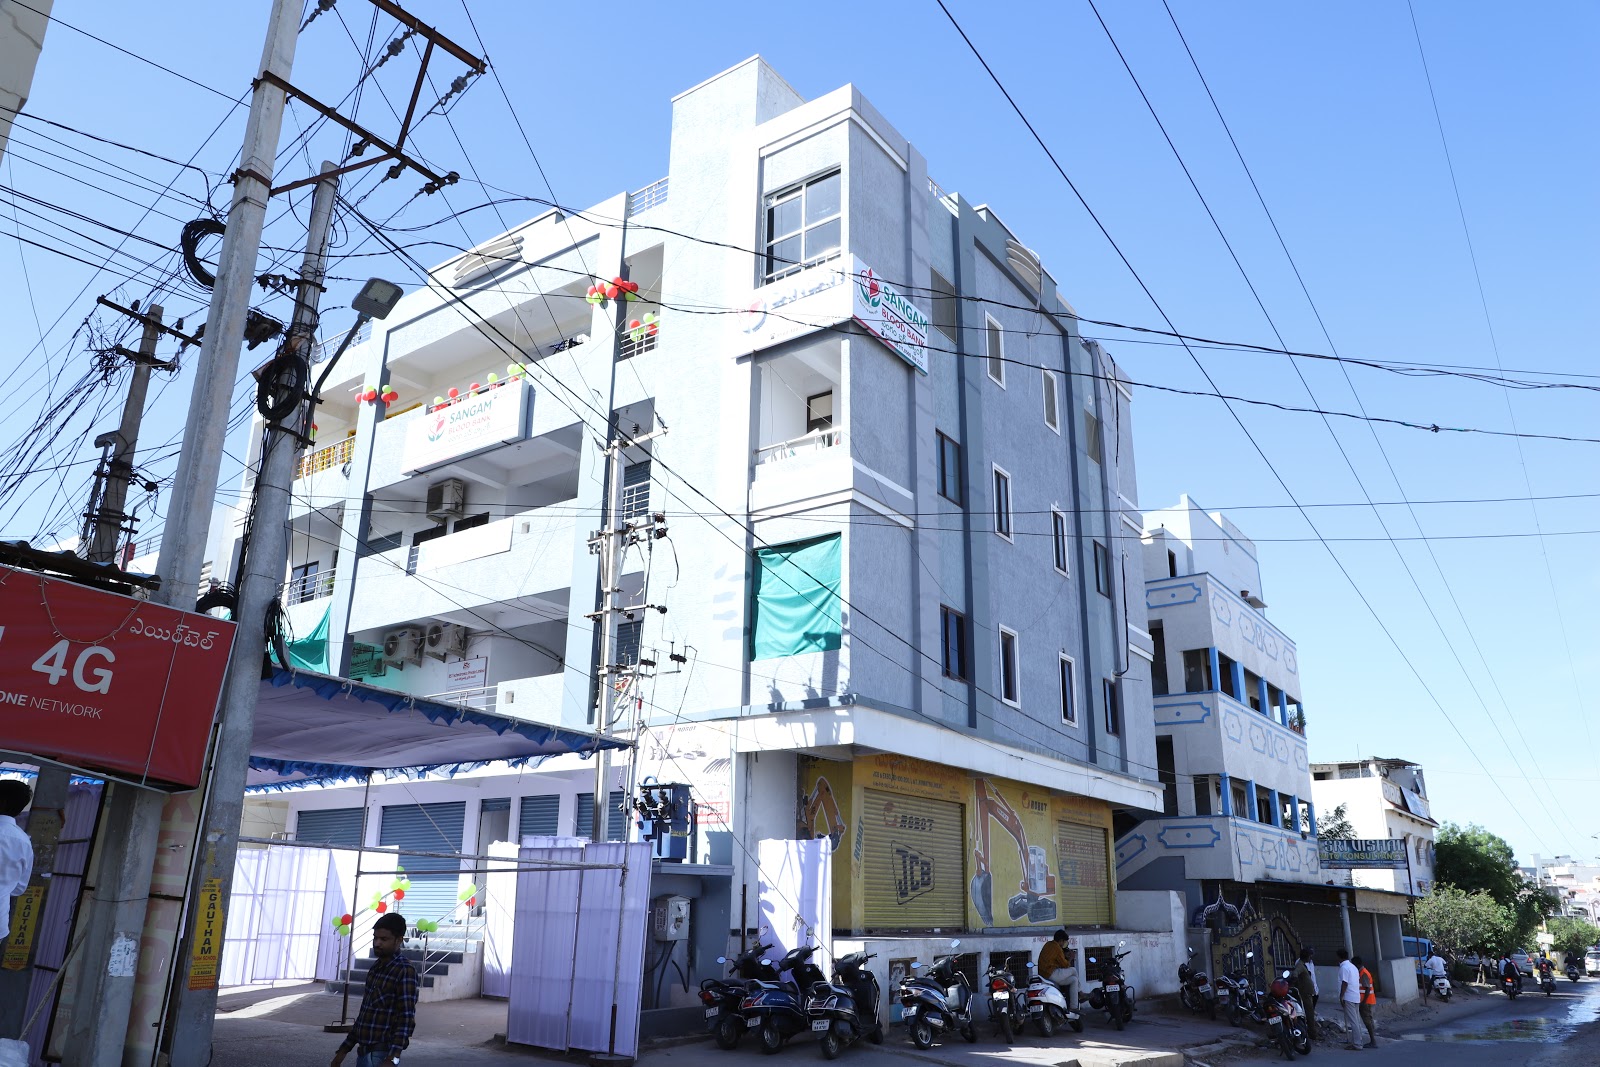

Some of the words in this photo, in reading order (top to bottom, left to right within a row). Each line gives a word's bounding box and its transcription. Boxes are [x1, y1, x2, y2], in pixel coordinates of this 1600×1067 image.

[882, 308, 906, 333] BLOOD
[907, 329, 925, 350] BANK
[883, 286, 928, 334] SANGAM
[448, 421, 471, 435] BLOOD
[472, 415, 491, 427] BANK
[449, 400, 493, 424] SANGAM
[31, 639, 116, 695] 4G
[29, 696, 103, 720] NETWORK
[853, 816, 864, 863] ROBOT
[899, 814, 935, 831] ROBOT
[1324, 840, 1350, 852] SRI
[1351, 839, 1404, 852] VISHAL
[1343, 852, 1405, 860] CONSULTANCY
[896, 848, 932, 898] JCB
[14, 897, 33, 945] GAUTHAM
[200, 893, 218, 955] GAUTHAM
